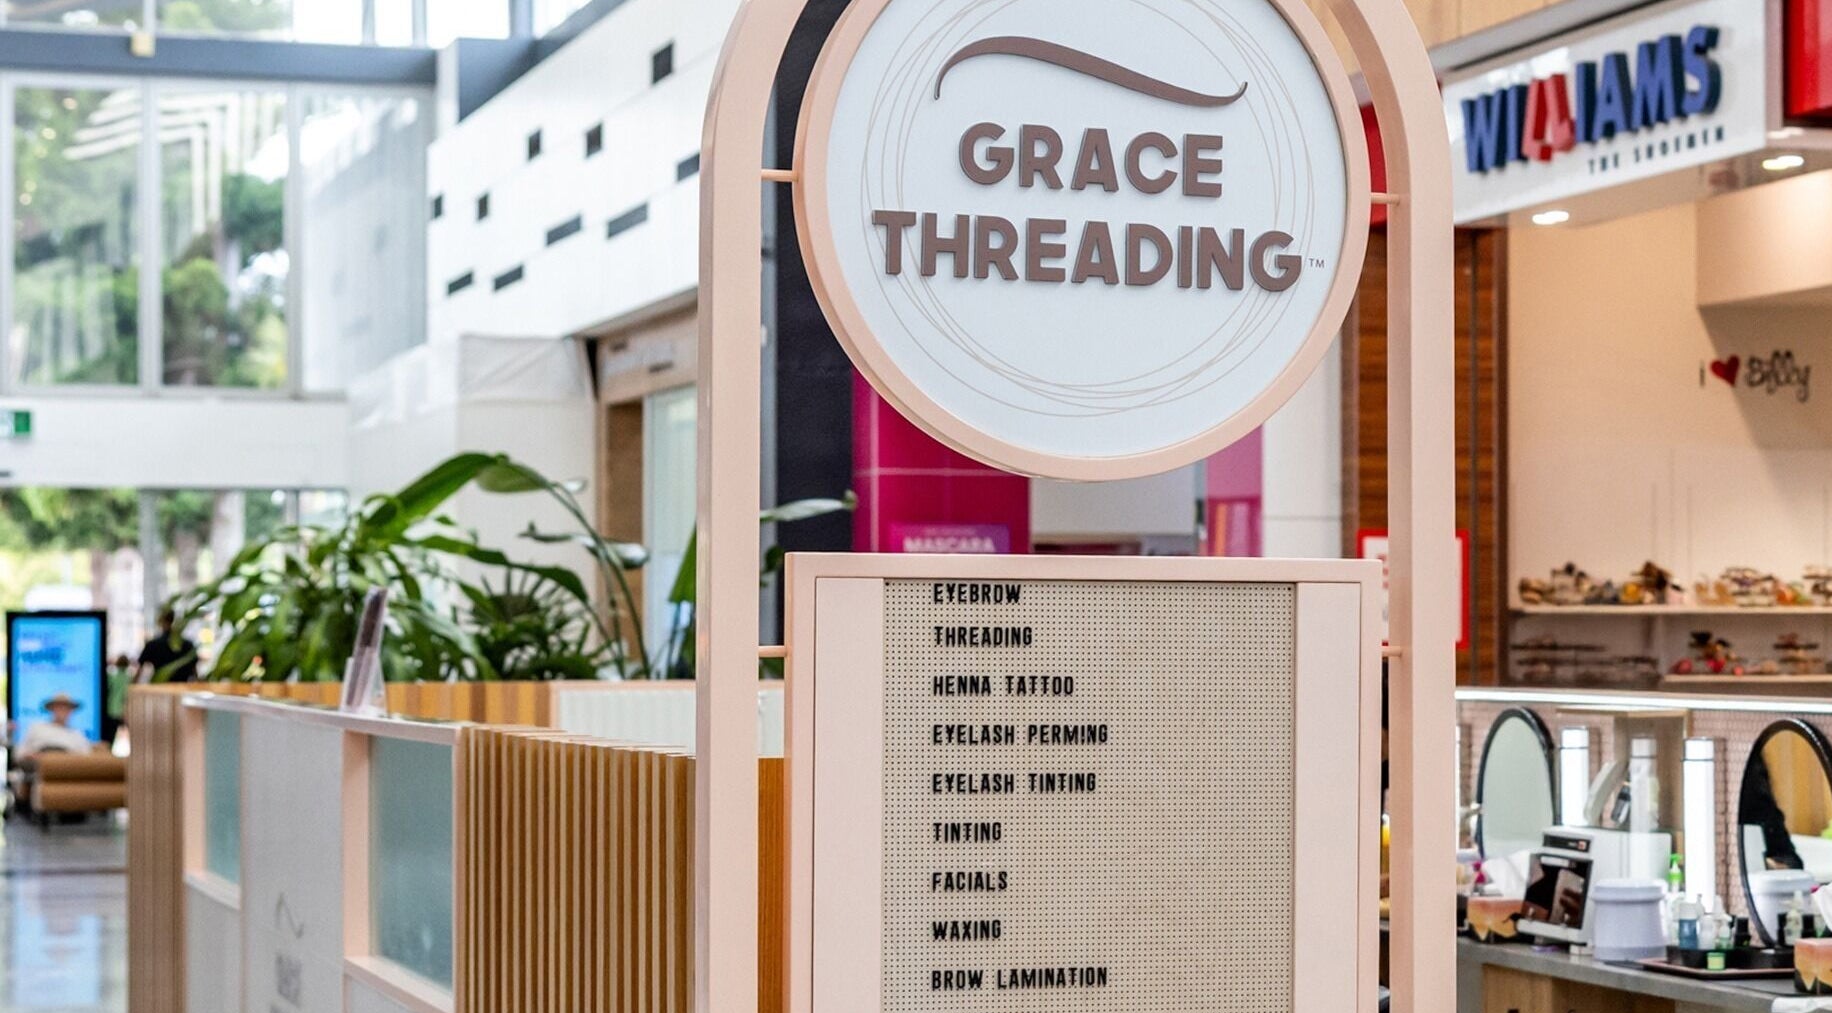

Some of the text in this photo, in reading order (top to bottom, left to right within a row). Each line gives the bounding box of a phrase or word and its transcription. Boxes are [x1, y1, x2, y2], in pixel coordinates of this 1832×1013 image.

[1461, 26, 1721, 175] WILLIAMS
[958, 121, 1224, 198] GRACE
[871, 209, 1303, 292] THREADING
[933, 583, 1022, 604] EYEBROW
[933, 626, 1034, 647] THREADING
[933, 675, 1075, 696] HENNA TATTOO
[933, 724, 1015, 745] EYELASH
[932, 773, 1097, 794] EYELASH TINTING
[932, 822, 1002, 843] TINTING
[932, 871, 1008, 893] FACIALS
[932, 920, 1001, 941] WAXING
[932, 967, 1109, 991] BROW LAMINATION
